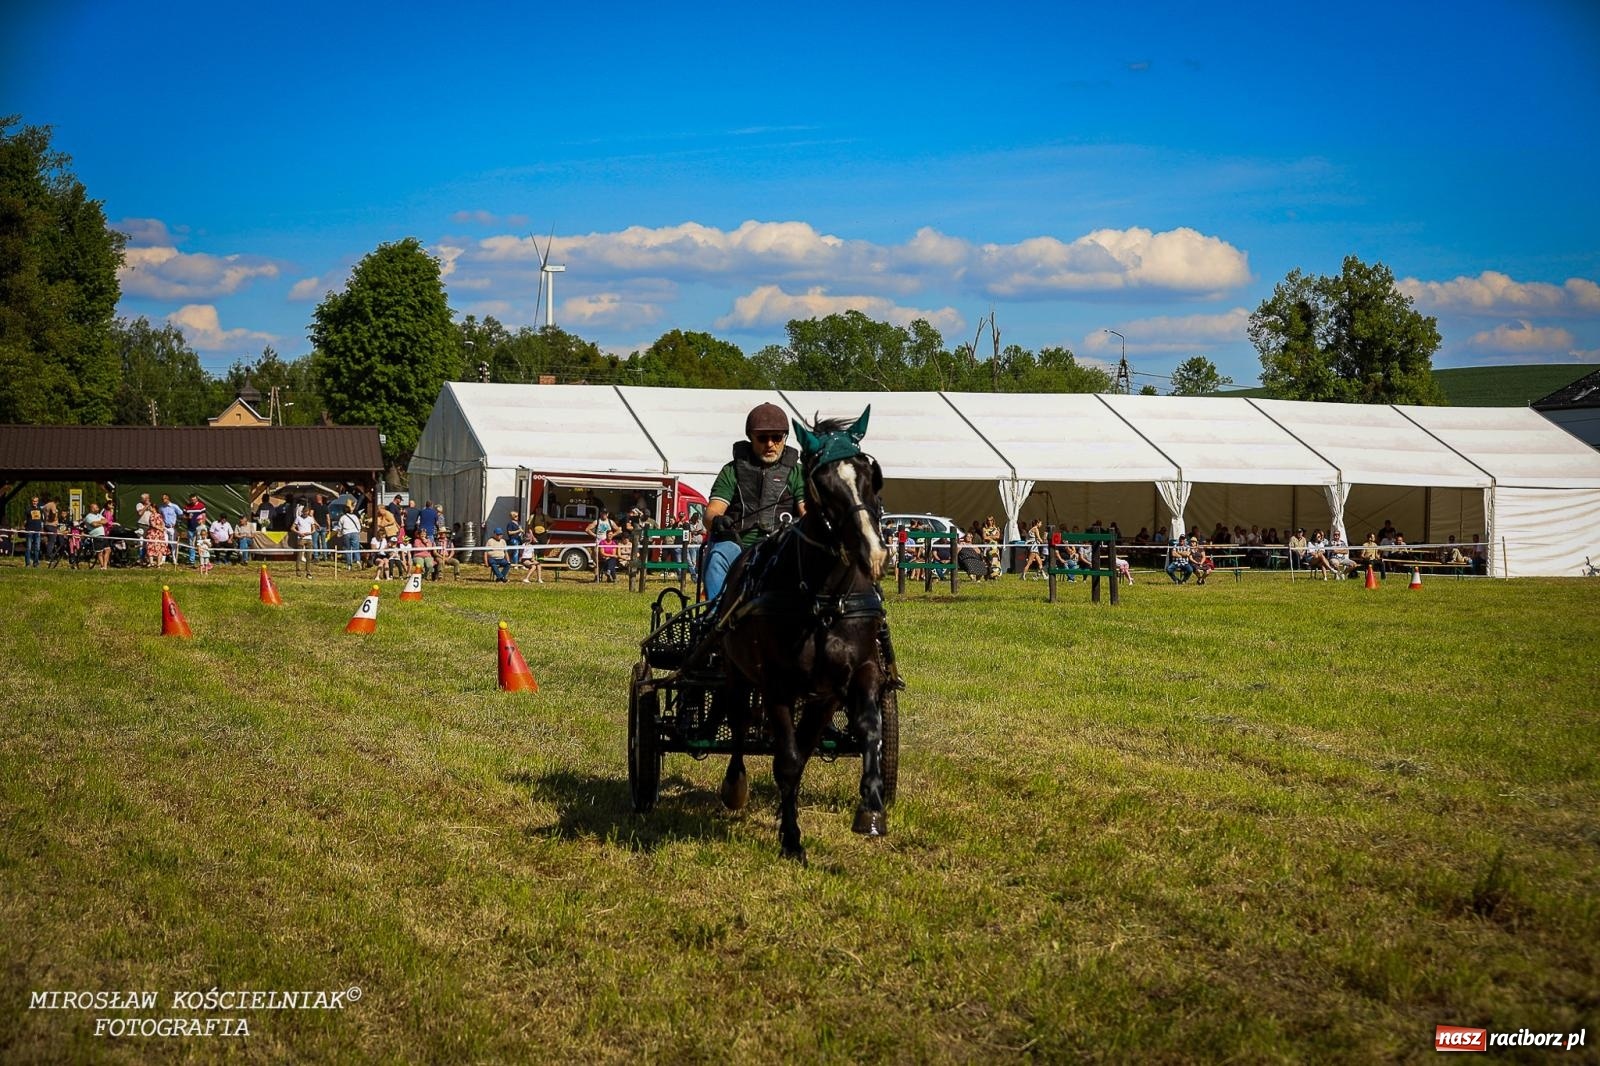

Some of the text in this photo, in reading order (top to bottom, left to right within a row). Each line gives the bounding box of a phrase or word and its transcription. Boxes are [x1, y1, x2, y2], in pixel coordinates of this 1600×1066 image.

[413, 576, 420, 588] 5
[362, 599, 372, 613] 6
[504, 645, 515, 667] 7
